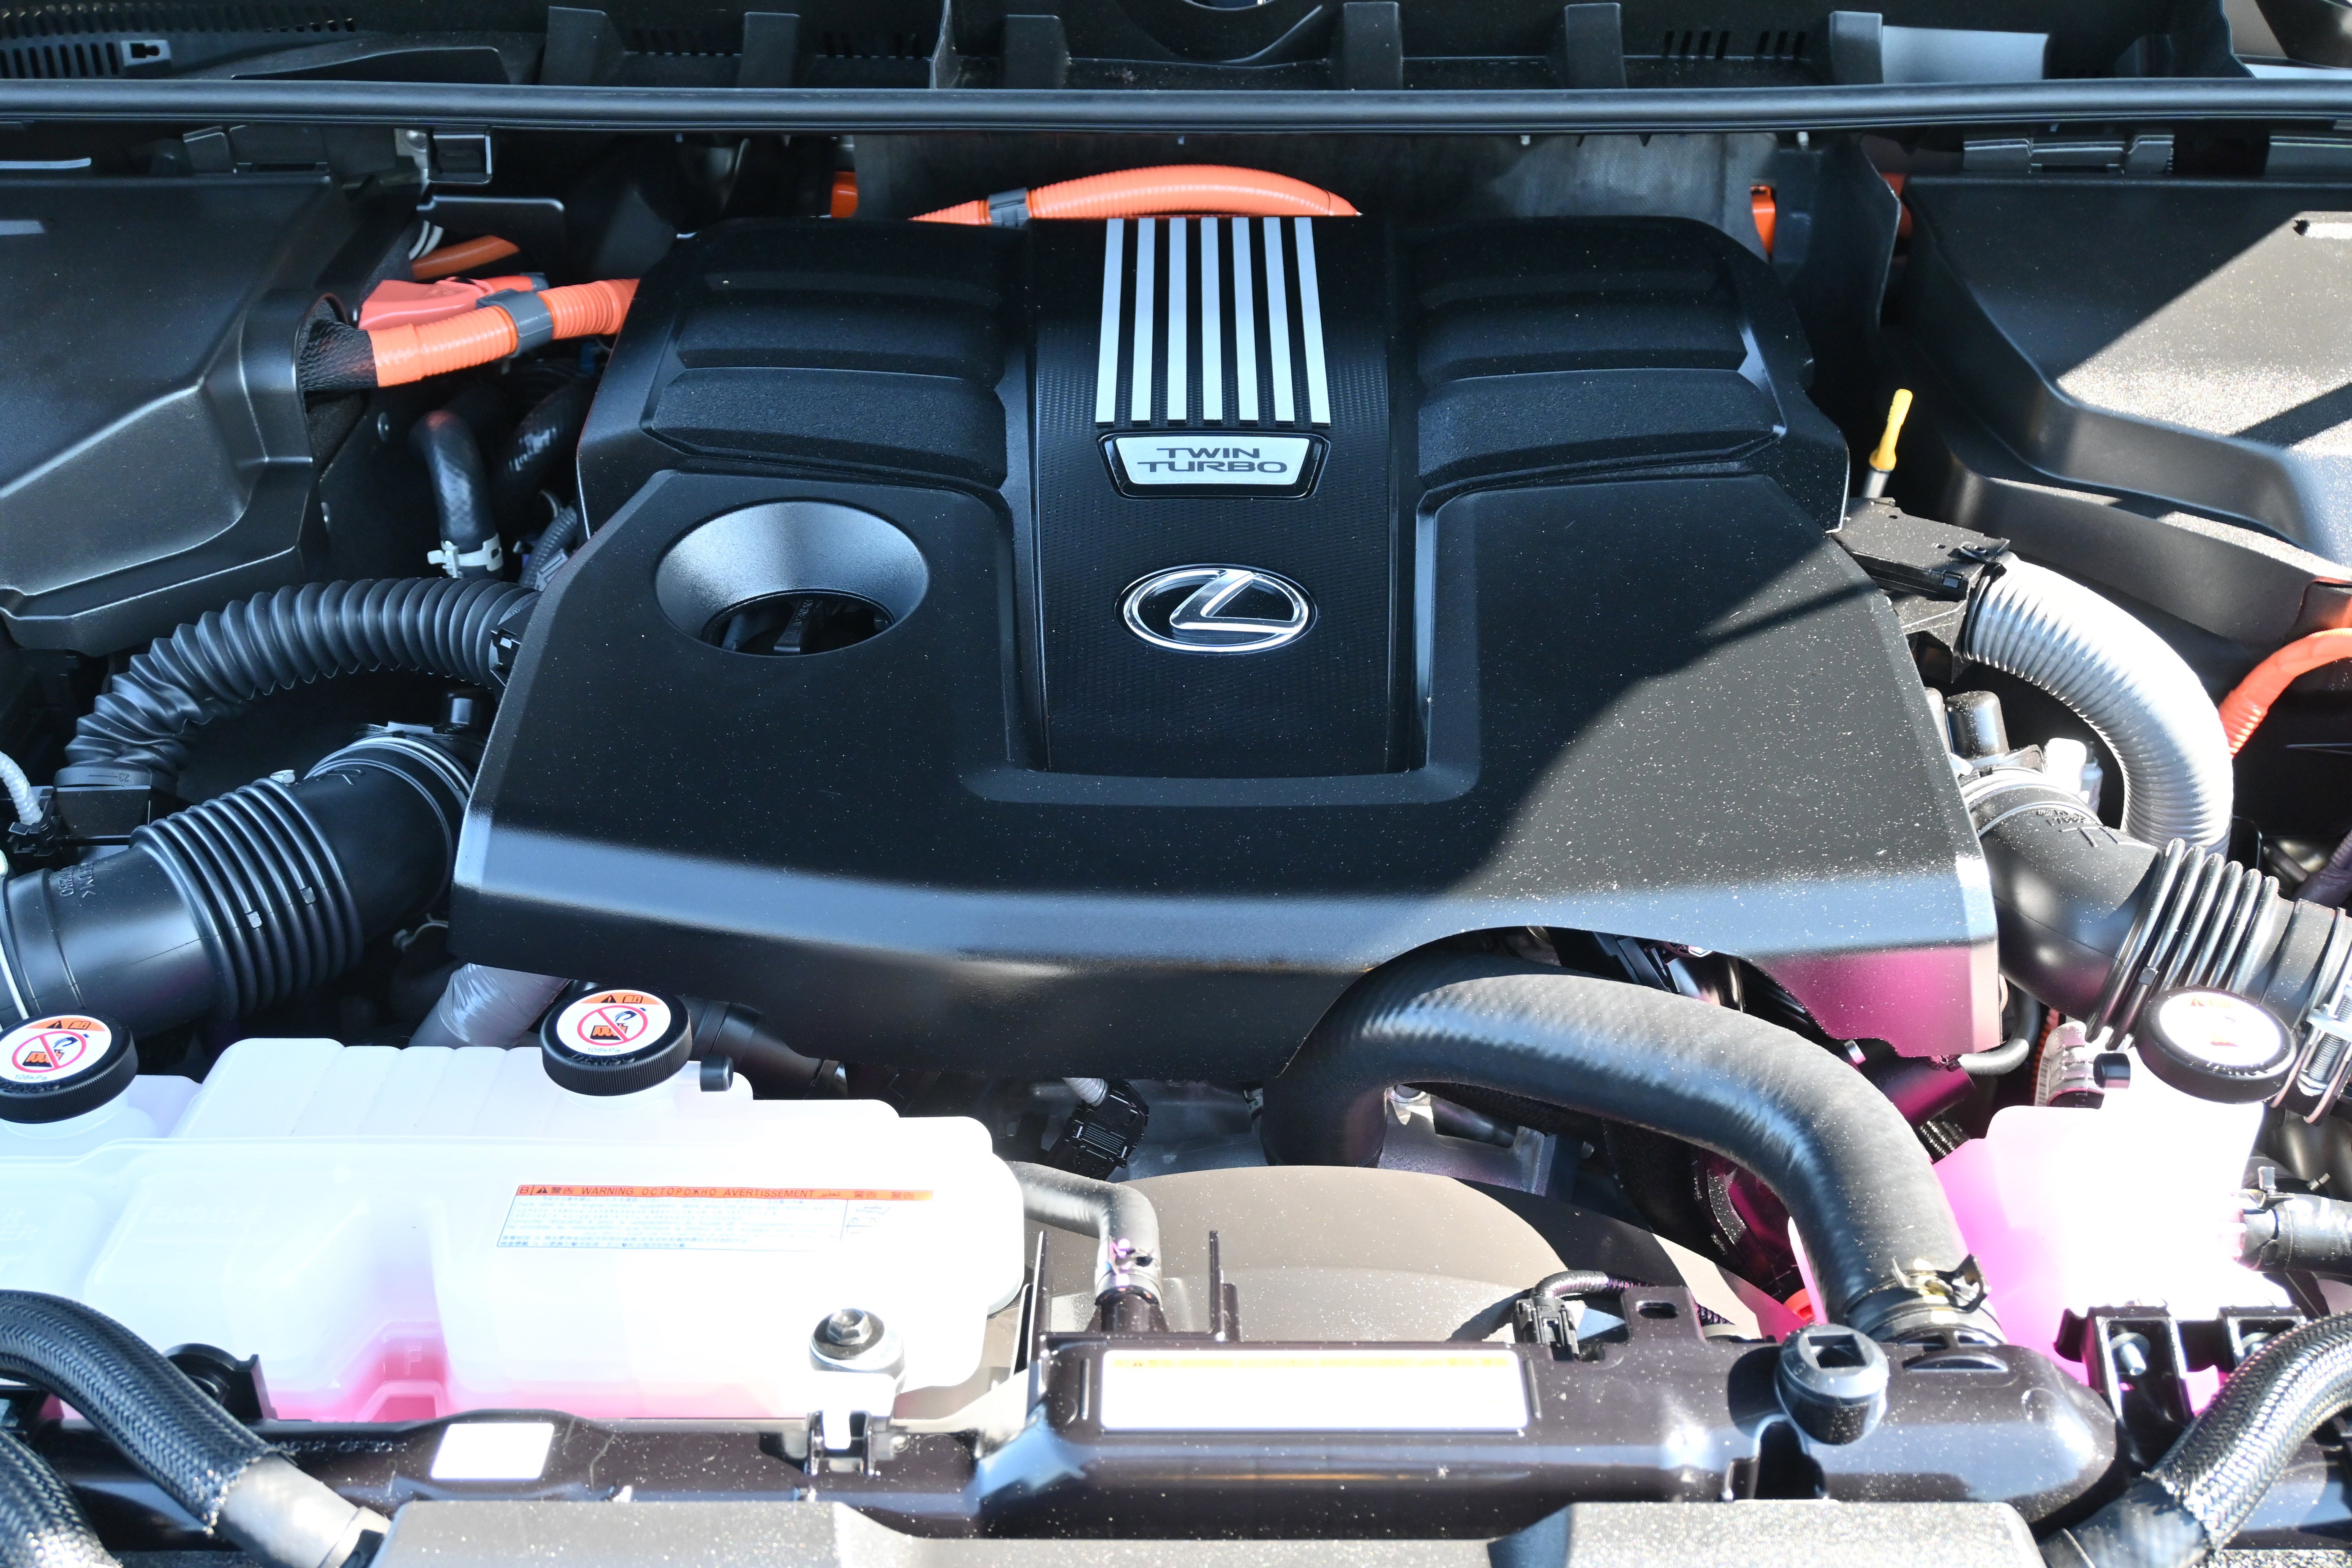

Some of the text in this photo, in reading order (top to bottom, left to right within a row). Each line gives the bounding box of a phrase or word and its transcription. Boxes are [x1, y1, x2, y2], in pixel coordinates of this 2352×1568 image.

[1157, 447, 1260, 459] TWIN
[1137, 461, 1288, 474] TURBO
[582, 1187, 634, 1195] WARNING
[642, 1187, 717, 1196] ОСТОРОЖНО
[724, 1188, 815, 1198] AVERTISSEMENT
